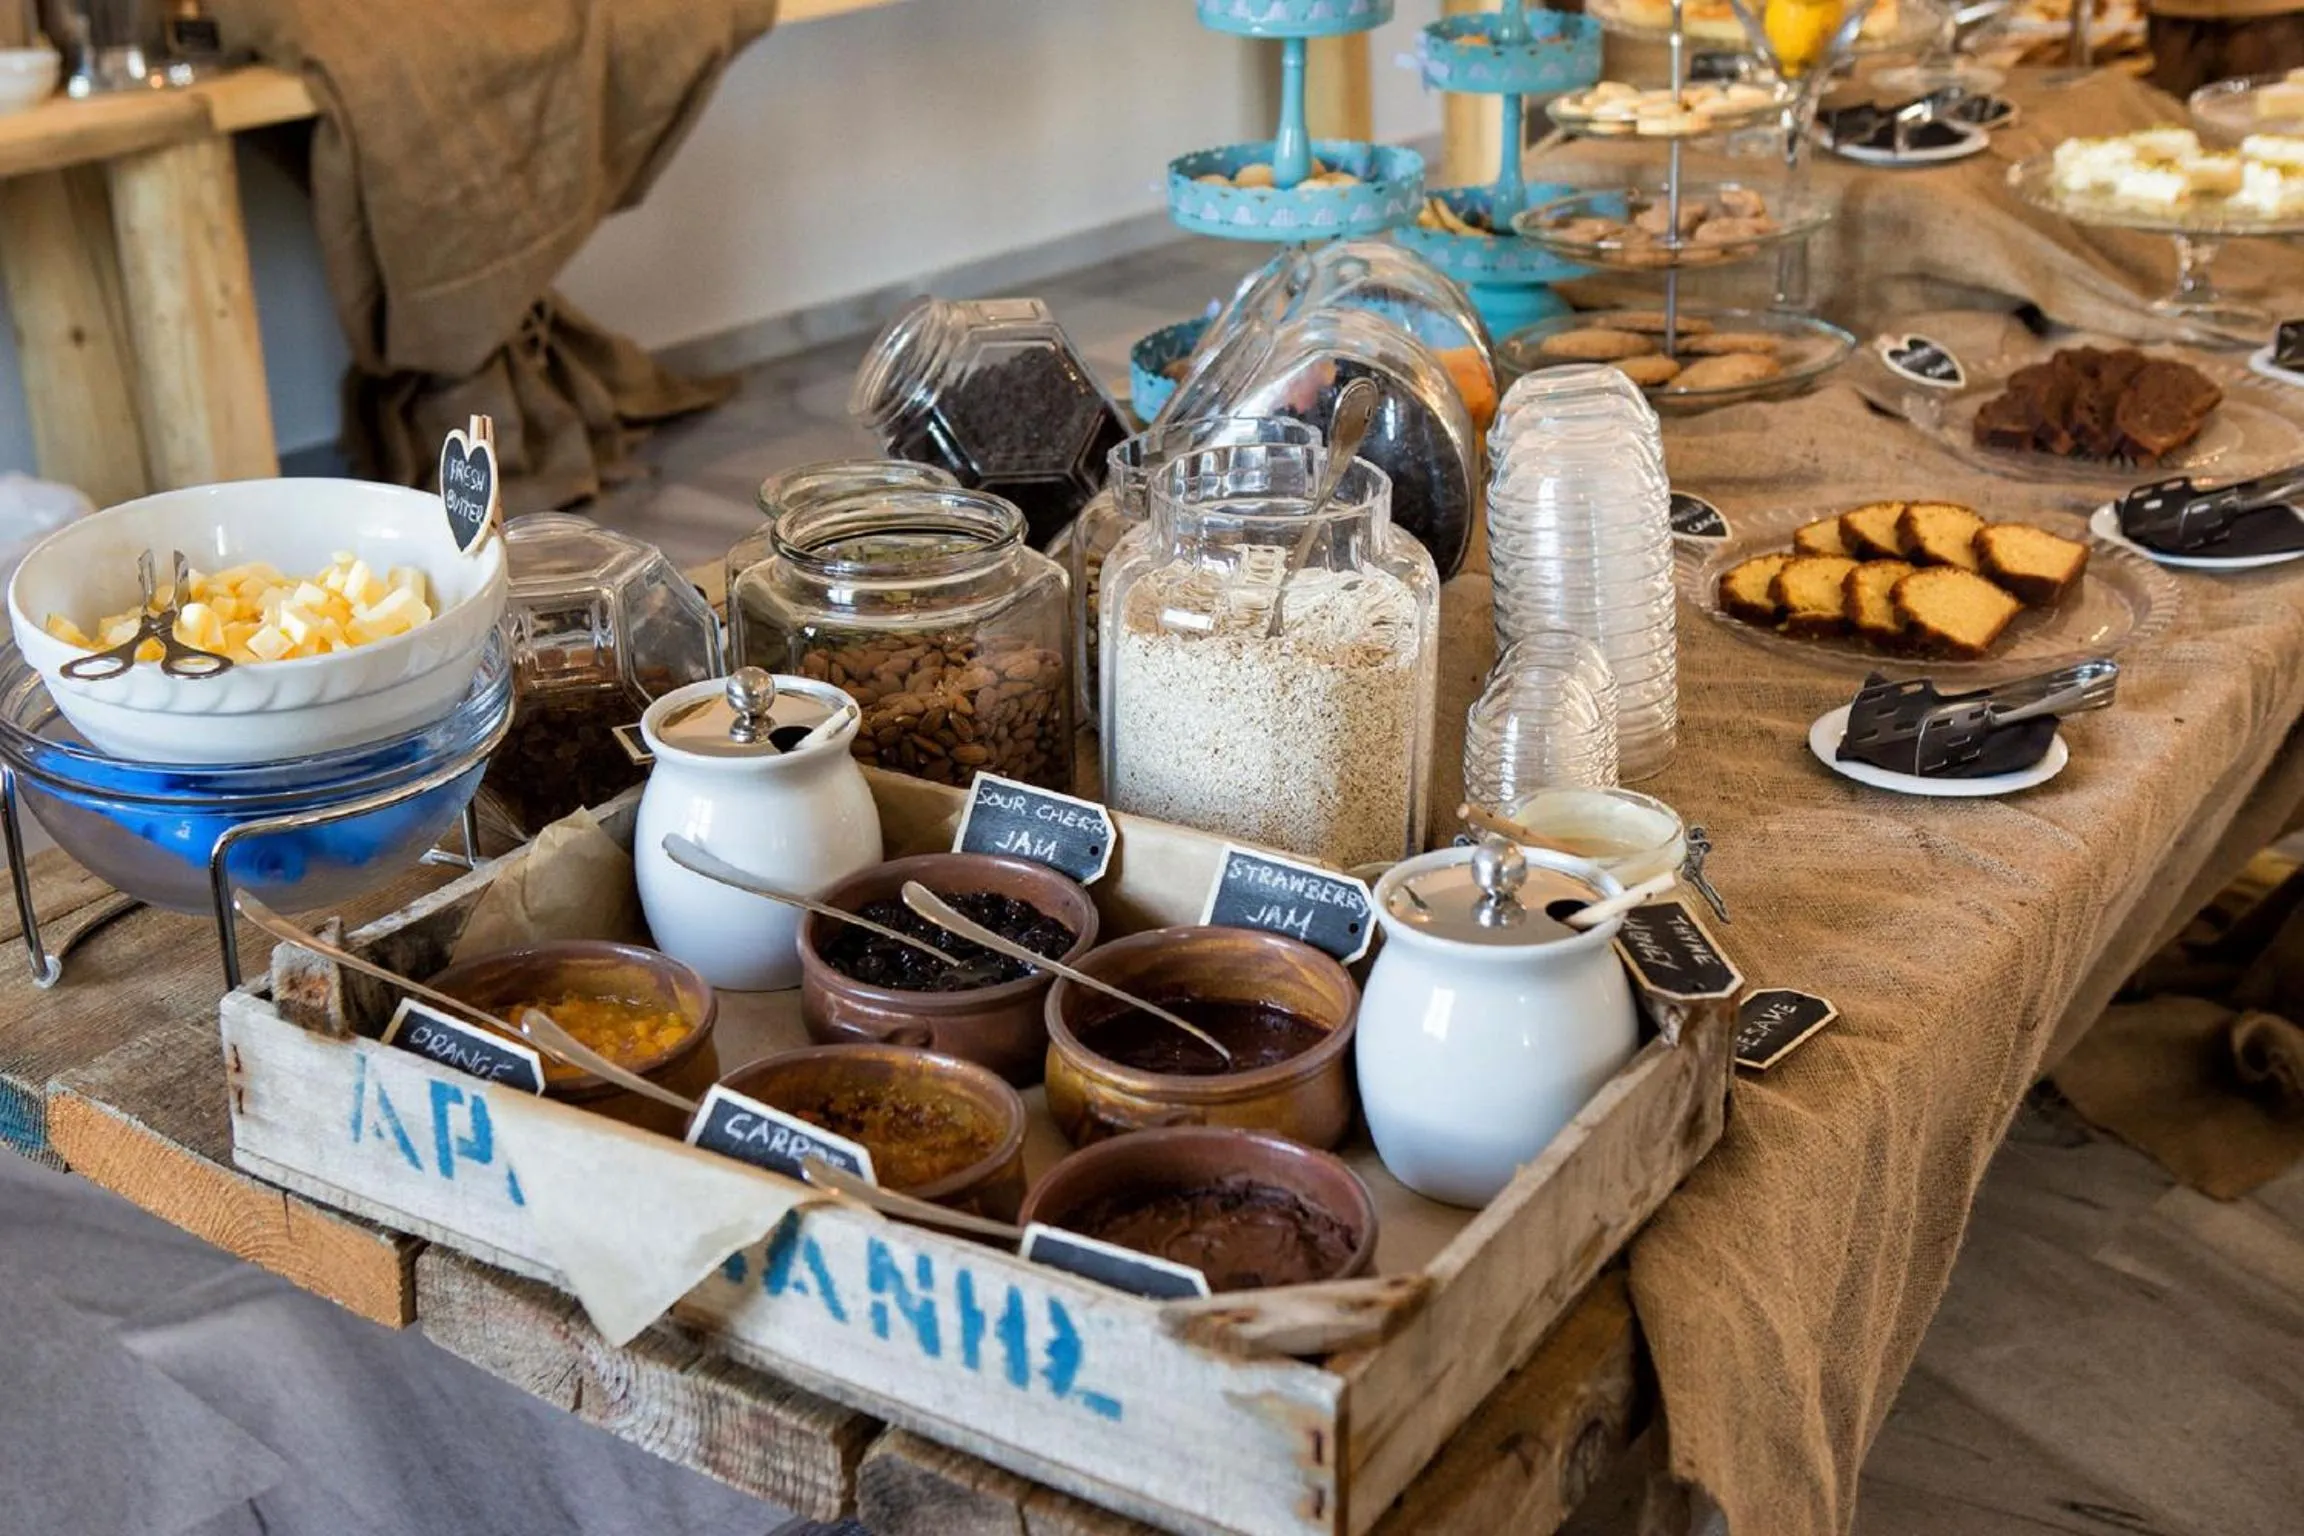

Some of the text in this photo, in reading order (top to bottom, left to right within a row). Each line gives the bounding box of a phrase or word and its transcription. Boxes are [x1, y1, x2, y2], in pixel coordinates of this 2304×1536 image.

[449, 456, 486, 492] FRESH
[446, 488, 484, 523] BUTTER
[976, 786, 1027, 817] SOUR
[994, 829, 1059, 862] JAM
[1228, 857, 1368, 919] STRAWBERRY
[1244, 904, 1315, 941] JAM
[409, 1025, 515, 1081] ORANGE
